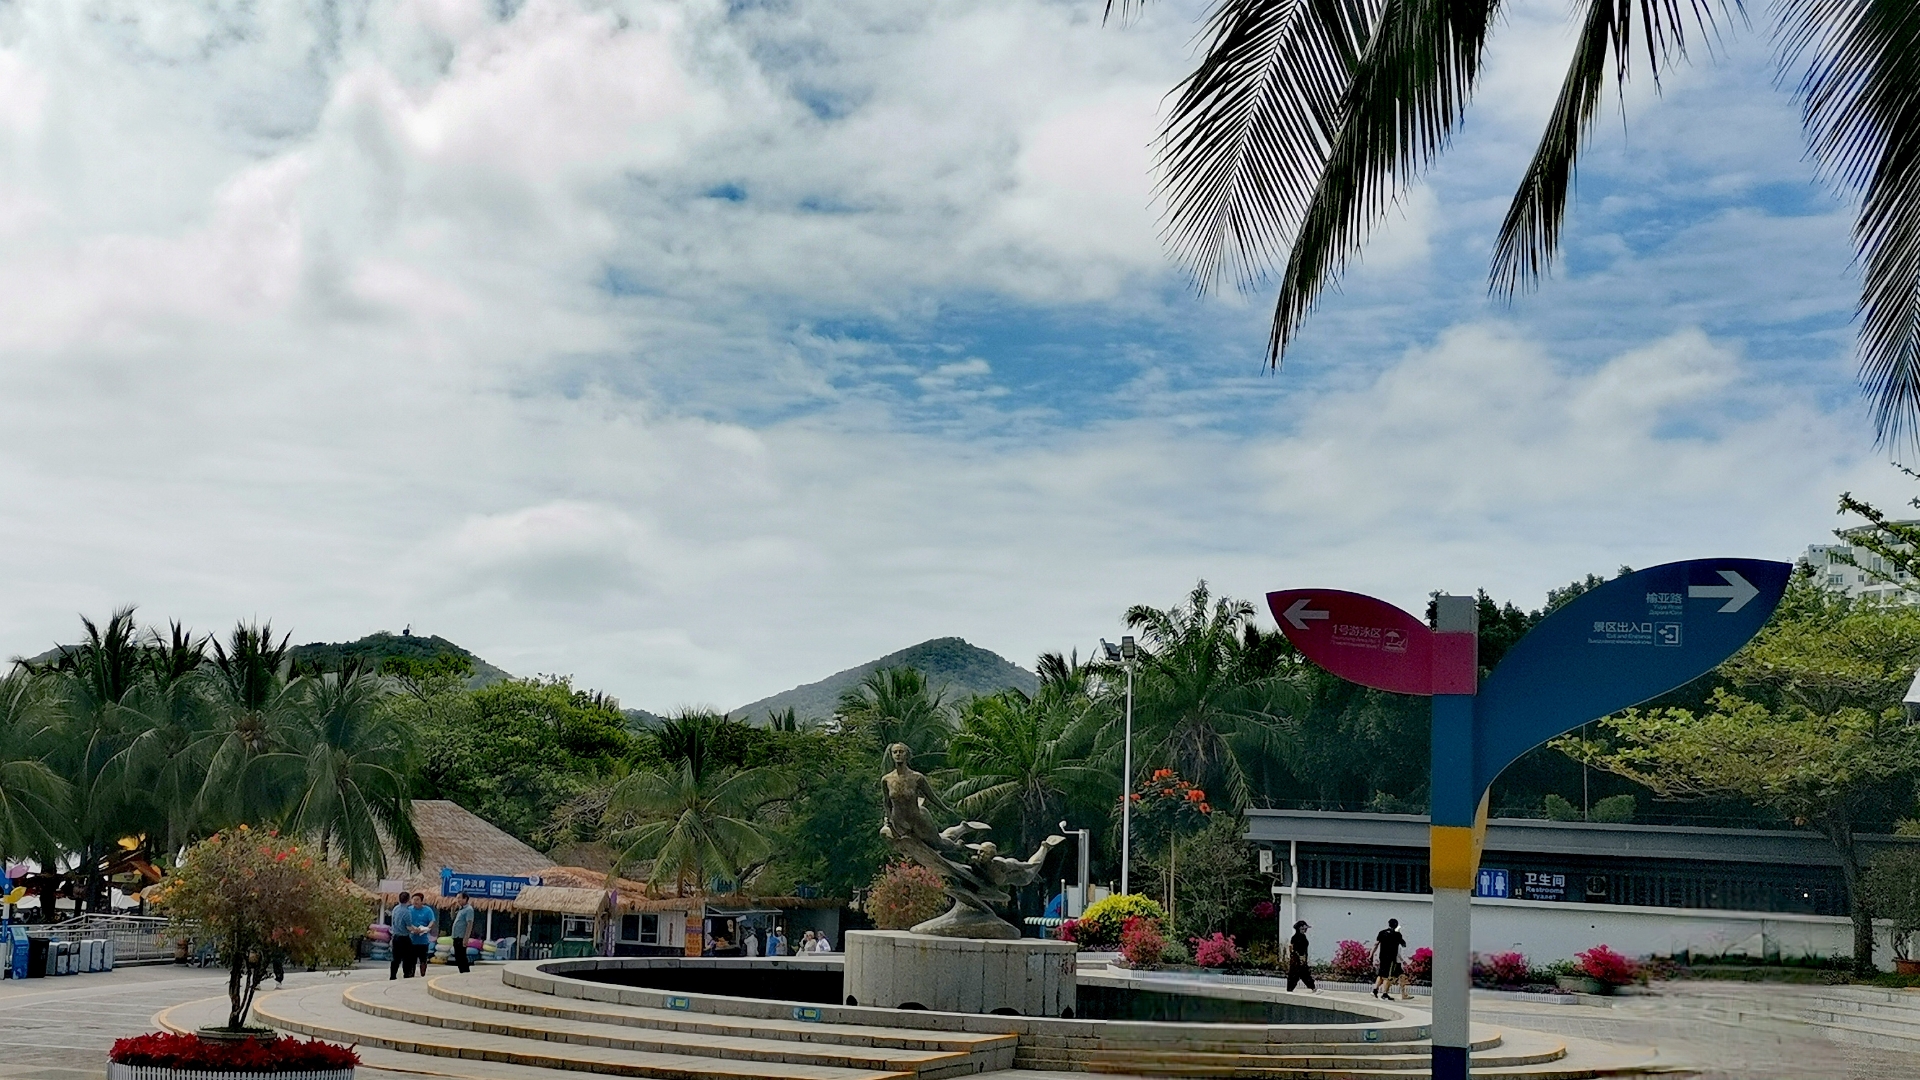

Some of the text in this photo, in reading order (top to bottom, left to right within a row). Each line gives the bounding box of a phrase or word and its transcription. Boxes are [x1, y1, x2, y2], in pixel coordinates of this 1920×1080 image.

[1646, 592, 1682, 604] 榆亚路
[1332, 624, 1381, 638] 1号游泳区
[1593, 621, 1653, 633] 景区出入口
[1525, 873, 1565, 887] 卫生间
[1526, 886, 1564, 894] Restrooms
